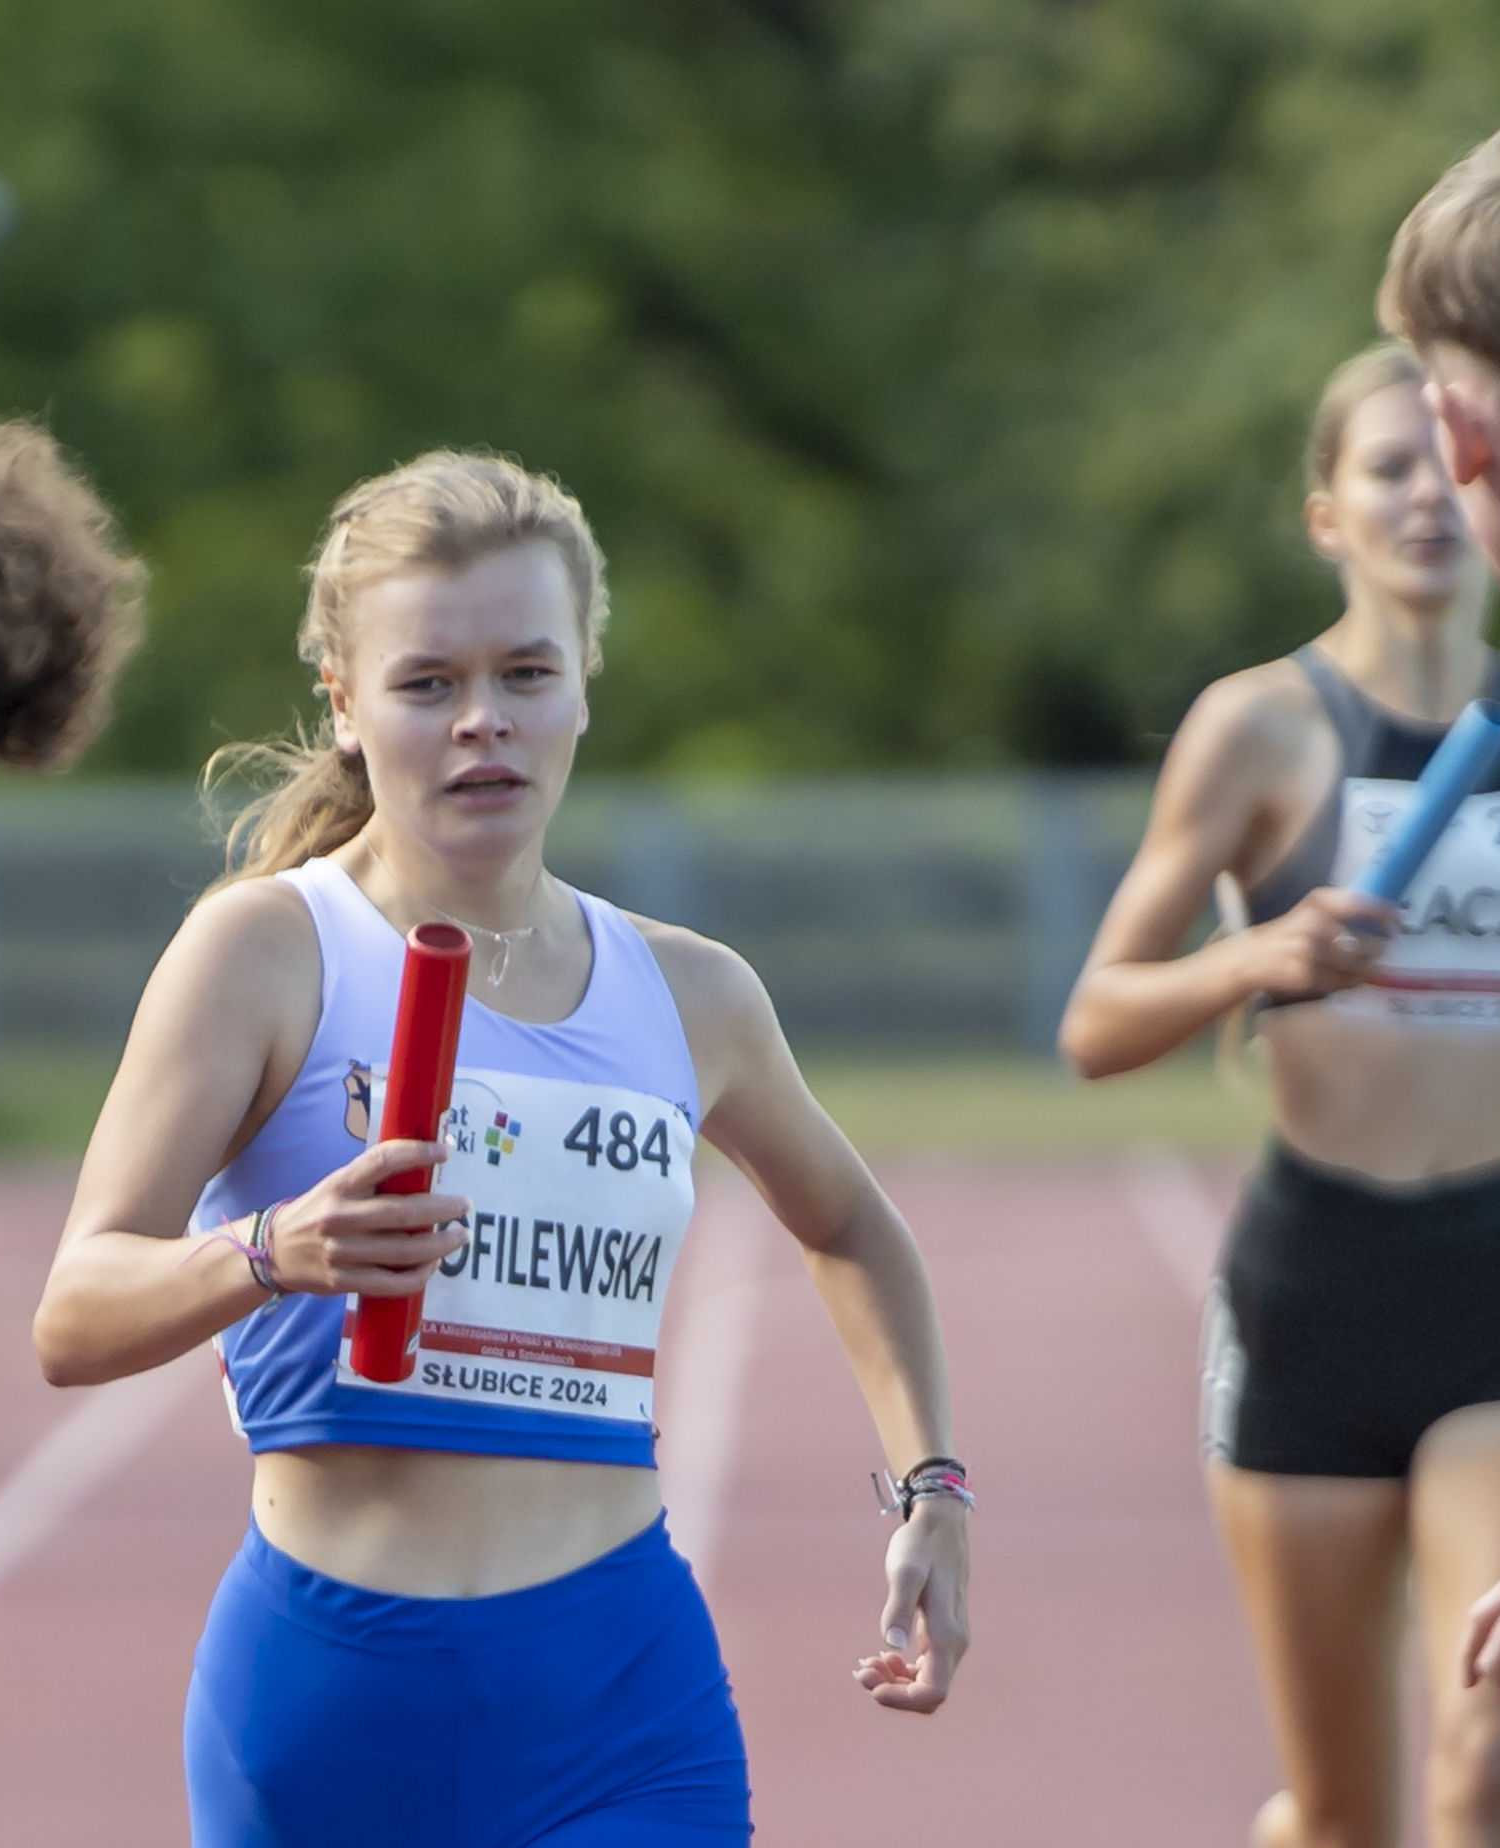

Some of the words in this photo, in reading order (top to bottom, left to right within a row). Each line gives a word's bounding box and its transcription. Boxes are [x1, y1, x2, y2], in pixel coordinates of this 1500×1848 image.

[563, 1106, 671, 1177] 484
[437, 1210, 663, 1303] OFILEWSKA
[421, 1361, 544, 1399] SŁUBICE
[549, 1377, 608, 1406] 2024
